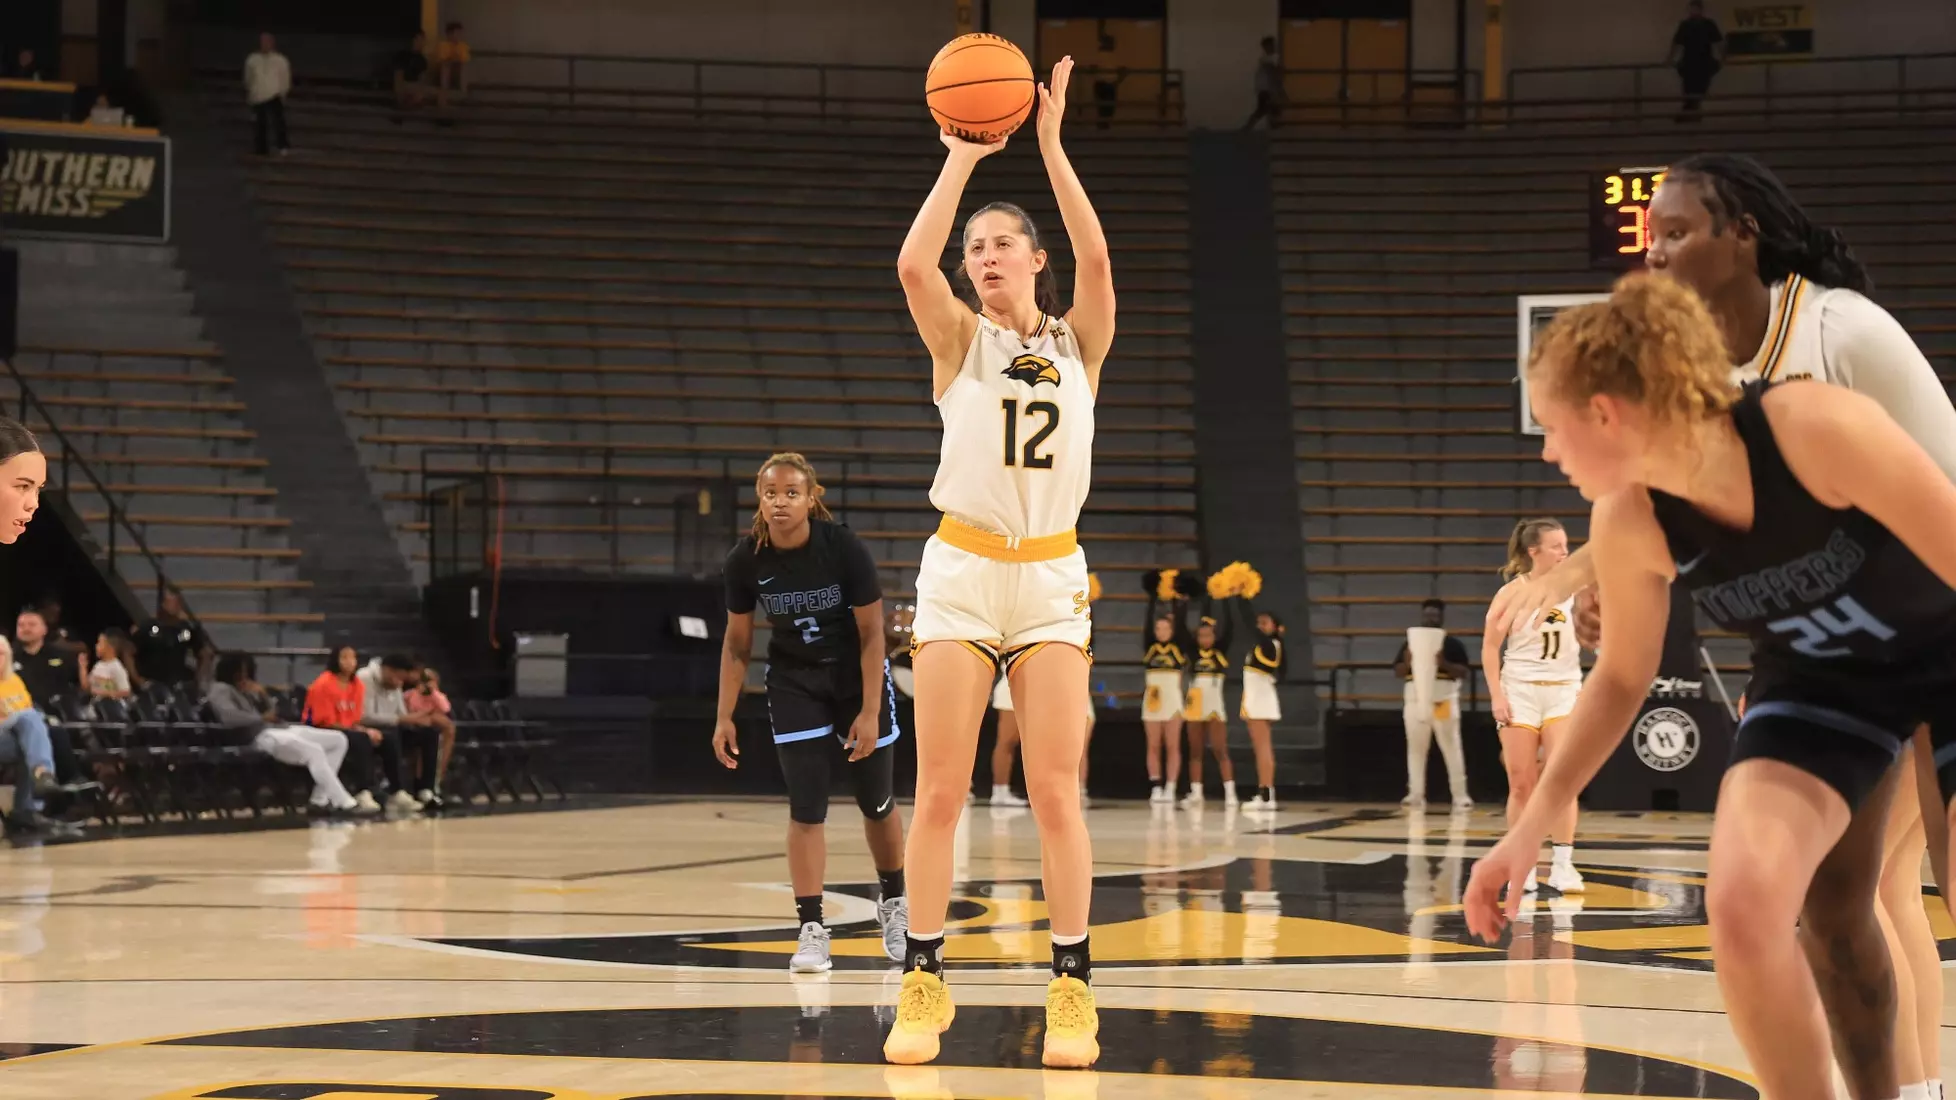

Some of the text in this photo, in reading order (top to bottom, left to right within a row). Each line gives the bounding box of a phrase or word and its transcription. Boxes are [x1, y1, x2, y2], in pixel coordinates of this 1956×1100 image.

[1733, 4, 1804, 28] WEST
[16, 184, 92, 217] MISS
[1001, 397, 1061, 470] 12
[1690, 526, 1866, 622] TOPPERS
[760, 584, 842, 615] TOPPERS
[794, 616, 824, 644] 2
[1766, 593, 1898, 658] 24
[1540, 630, 1561, 660] 11
